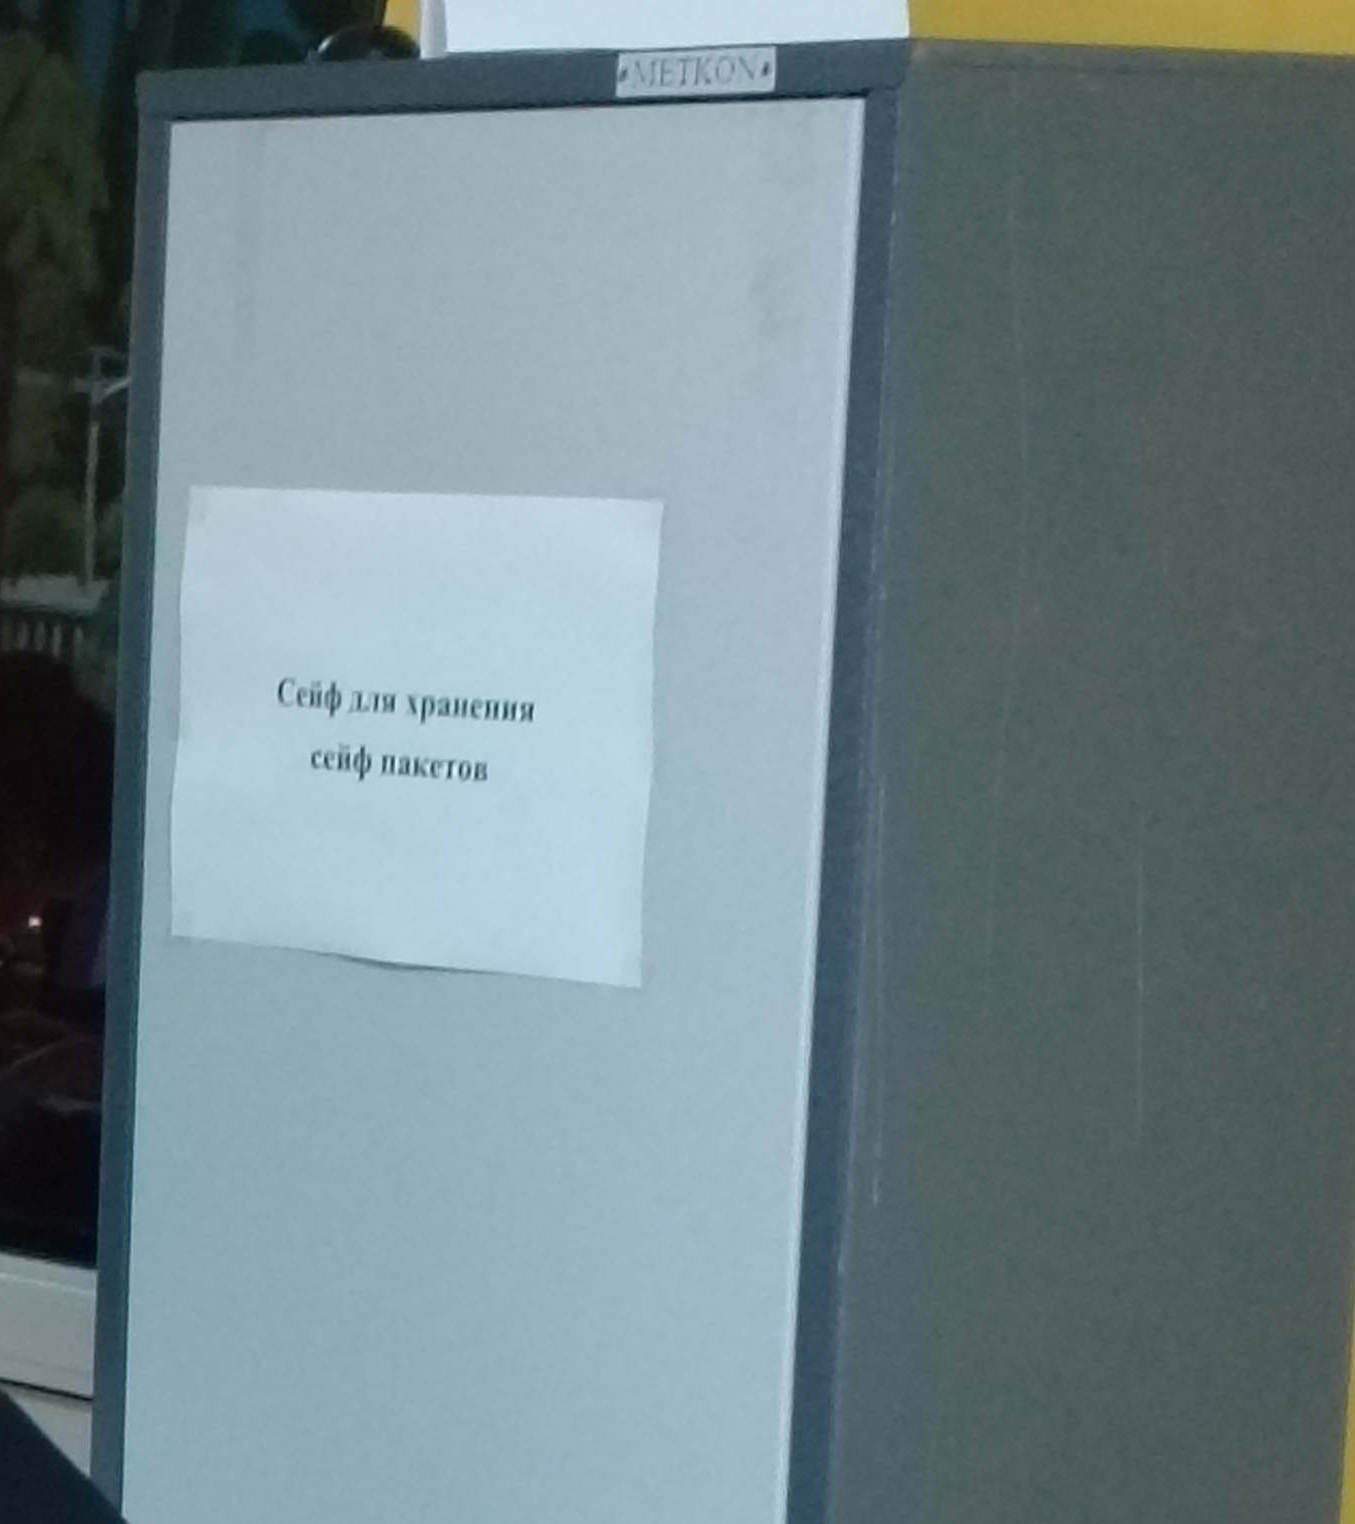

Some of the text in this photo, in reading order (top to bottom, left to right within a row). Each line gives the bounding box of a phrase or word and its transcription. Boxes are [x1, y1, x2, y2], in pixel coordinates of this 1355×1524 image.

[631, 55, 759, 88] METKON
[276, 677, 535, 726] Сейф для хранения
[309, 743, 488, 783] сейф пакетов
